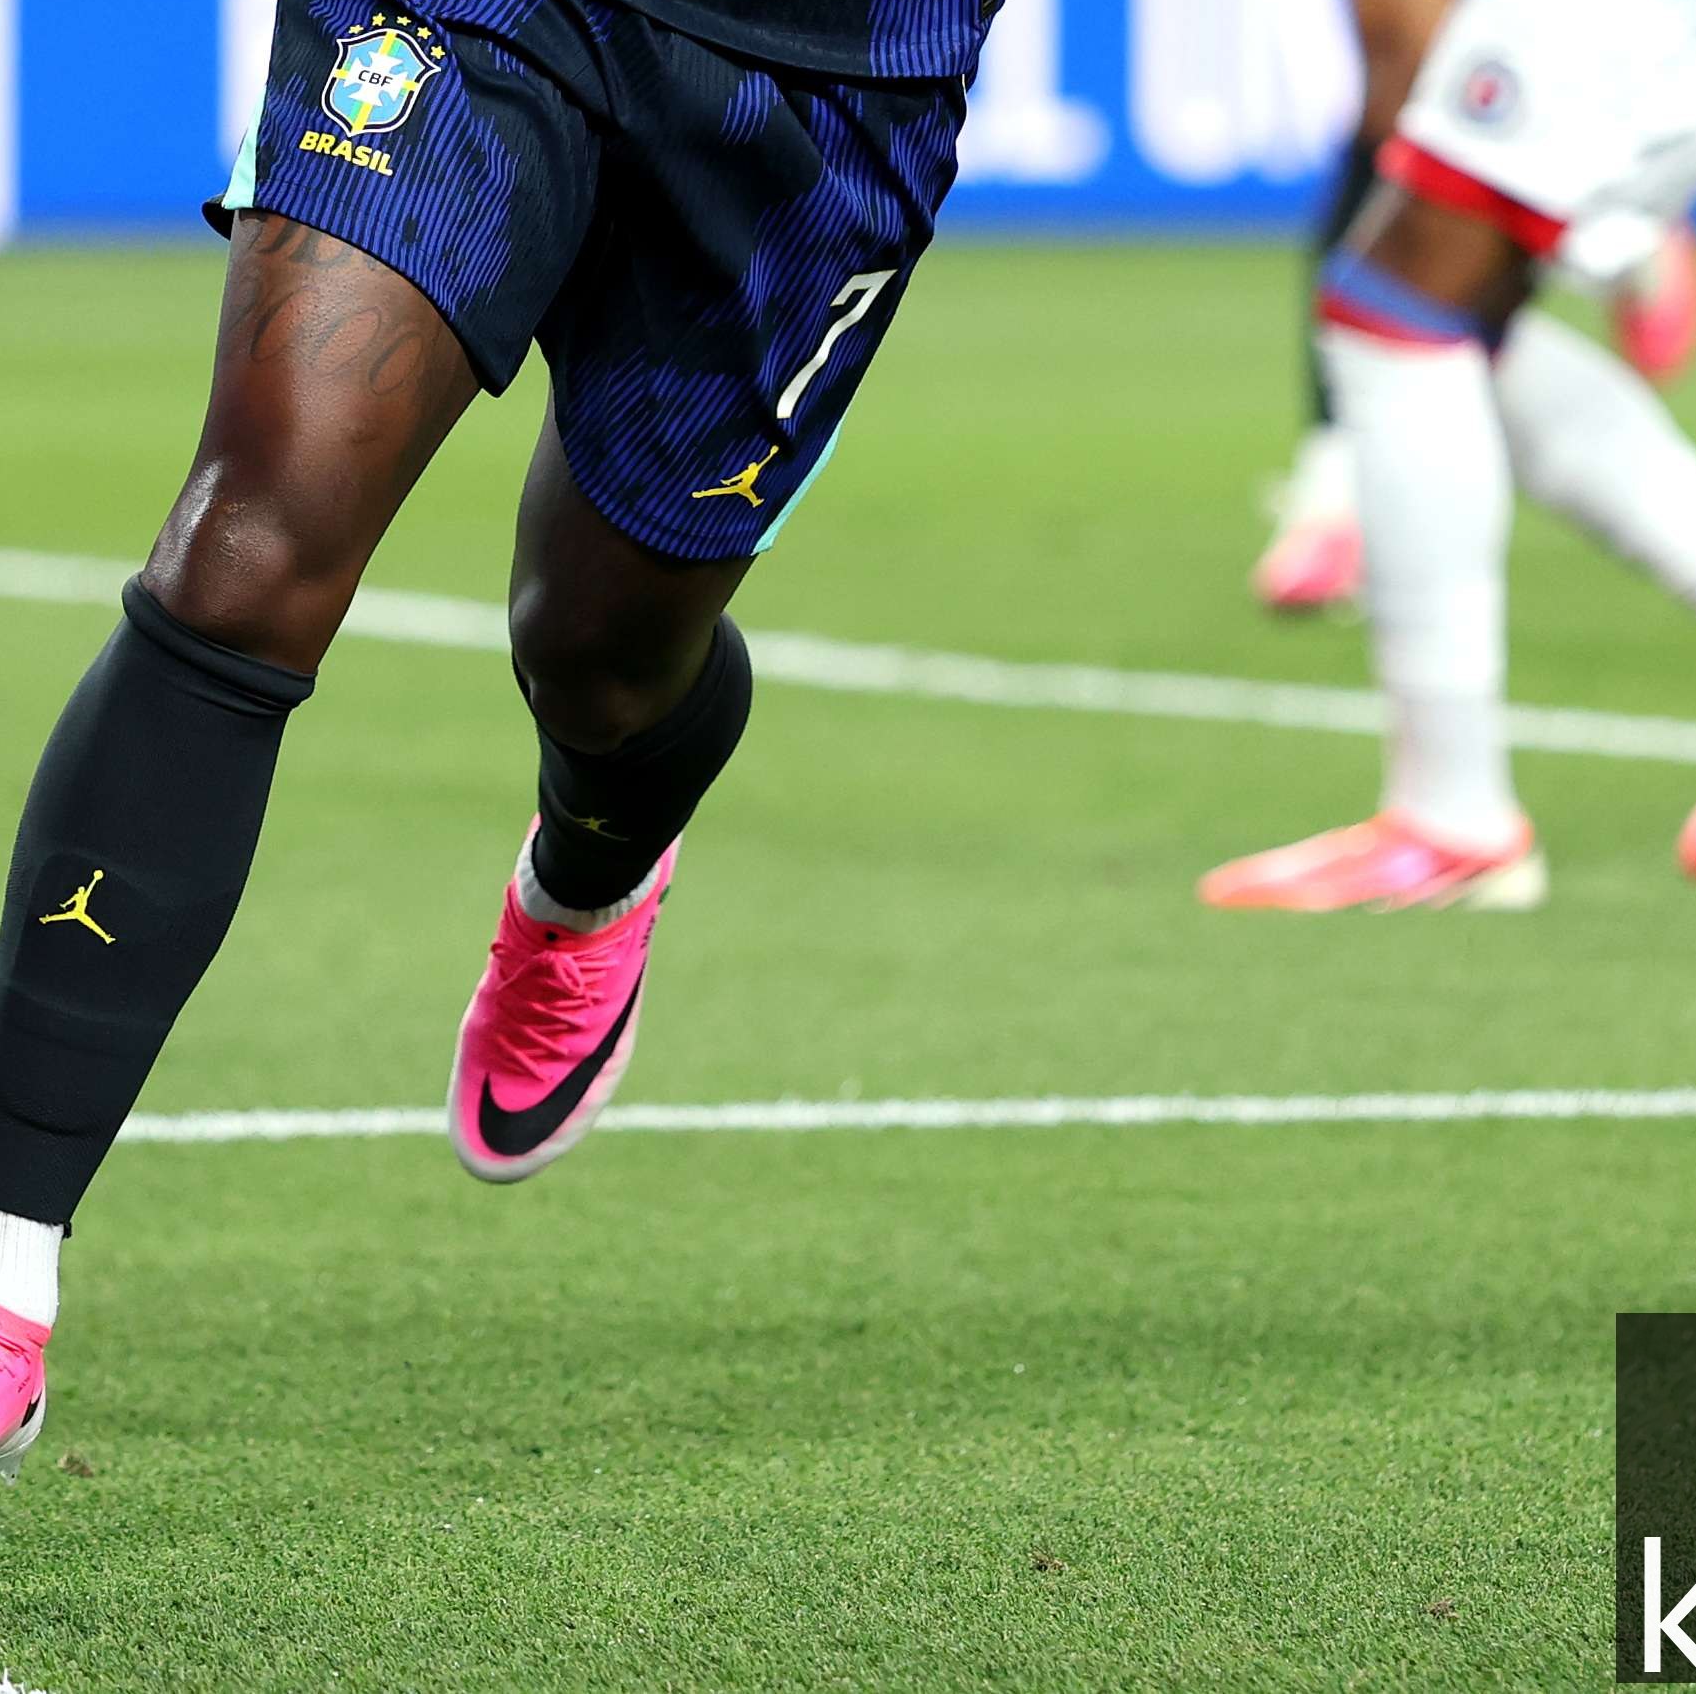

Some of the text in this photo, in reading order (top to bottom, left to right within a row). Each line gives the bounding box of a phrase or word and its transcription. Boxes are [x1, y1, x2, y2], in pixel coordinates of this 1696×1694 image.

[358, 69, 393, 88] CBF
[298, 130, 394, 176] BRASIL
[777, 269, 898, 419] 7
